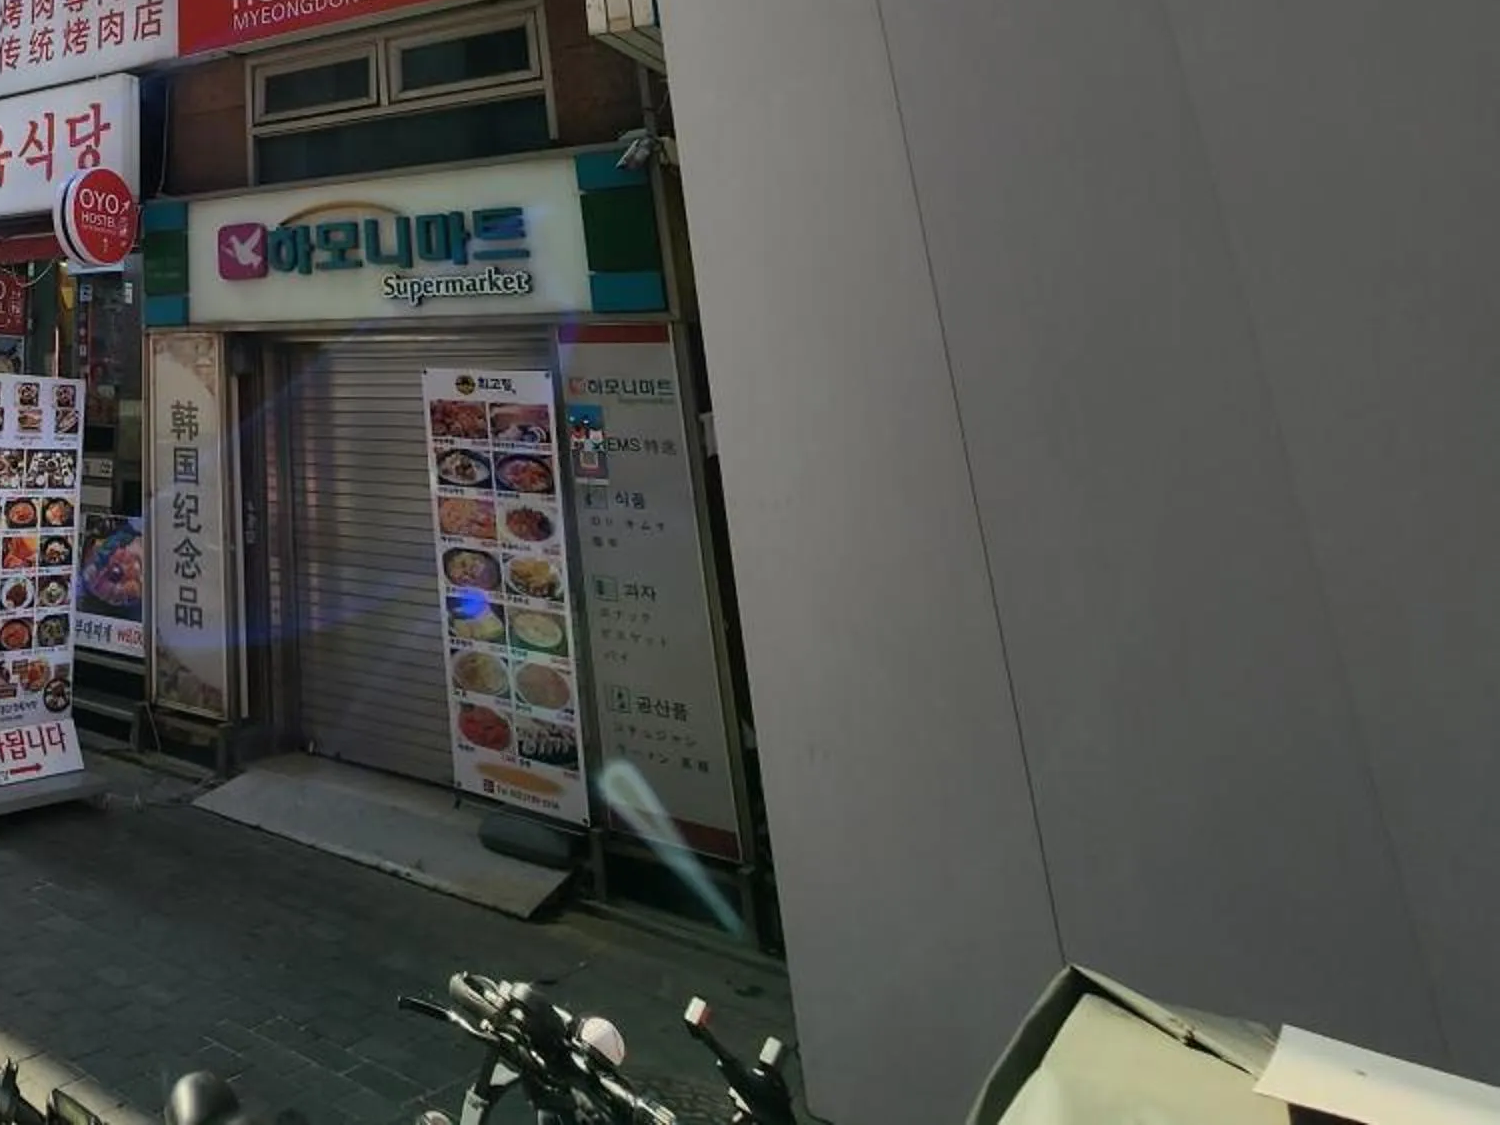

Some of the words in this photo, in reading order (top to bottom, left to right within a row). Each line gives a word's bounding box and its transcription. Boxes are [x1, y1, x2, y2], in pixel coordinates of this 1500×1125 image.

[80, 188, 119, 215] OYO
[267, 206, 531, 275] 하모니마트
[382, 266, 532, 305] Supermarket
[607, 437, 642, 453] EMS
[169, 400, 204, 629] 韩国纪念品
